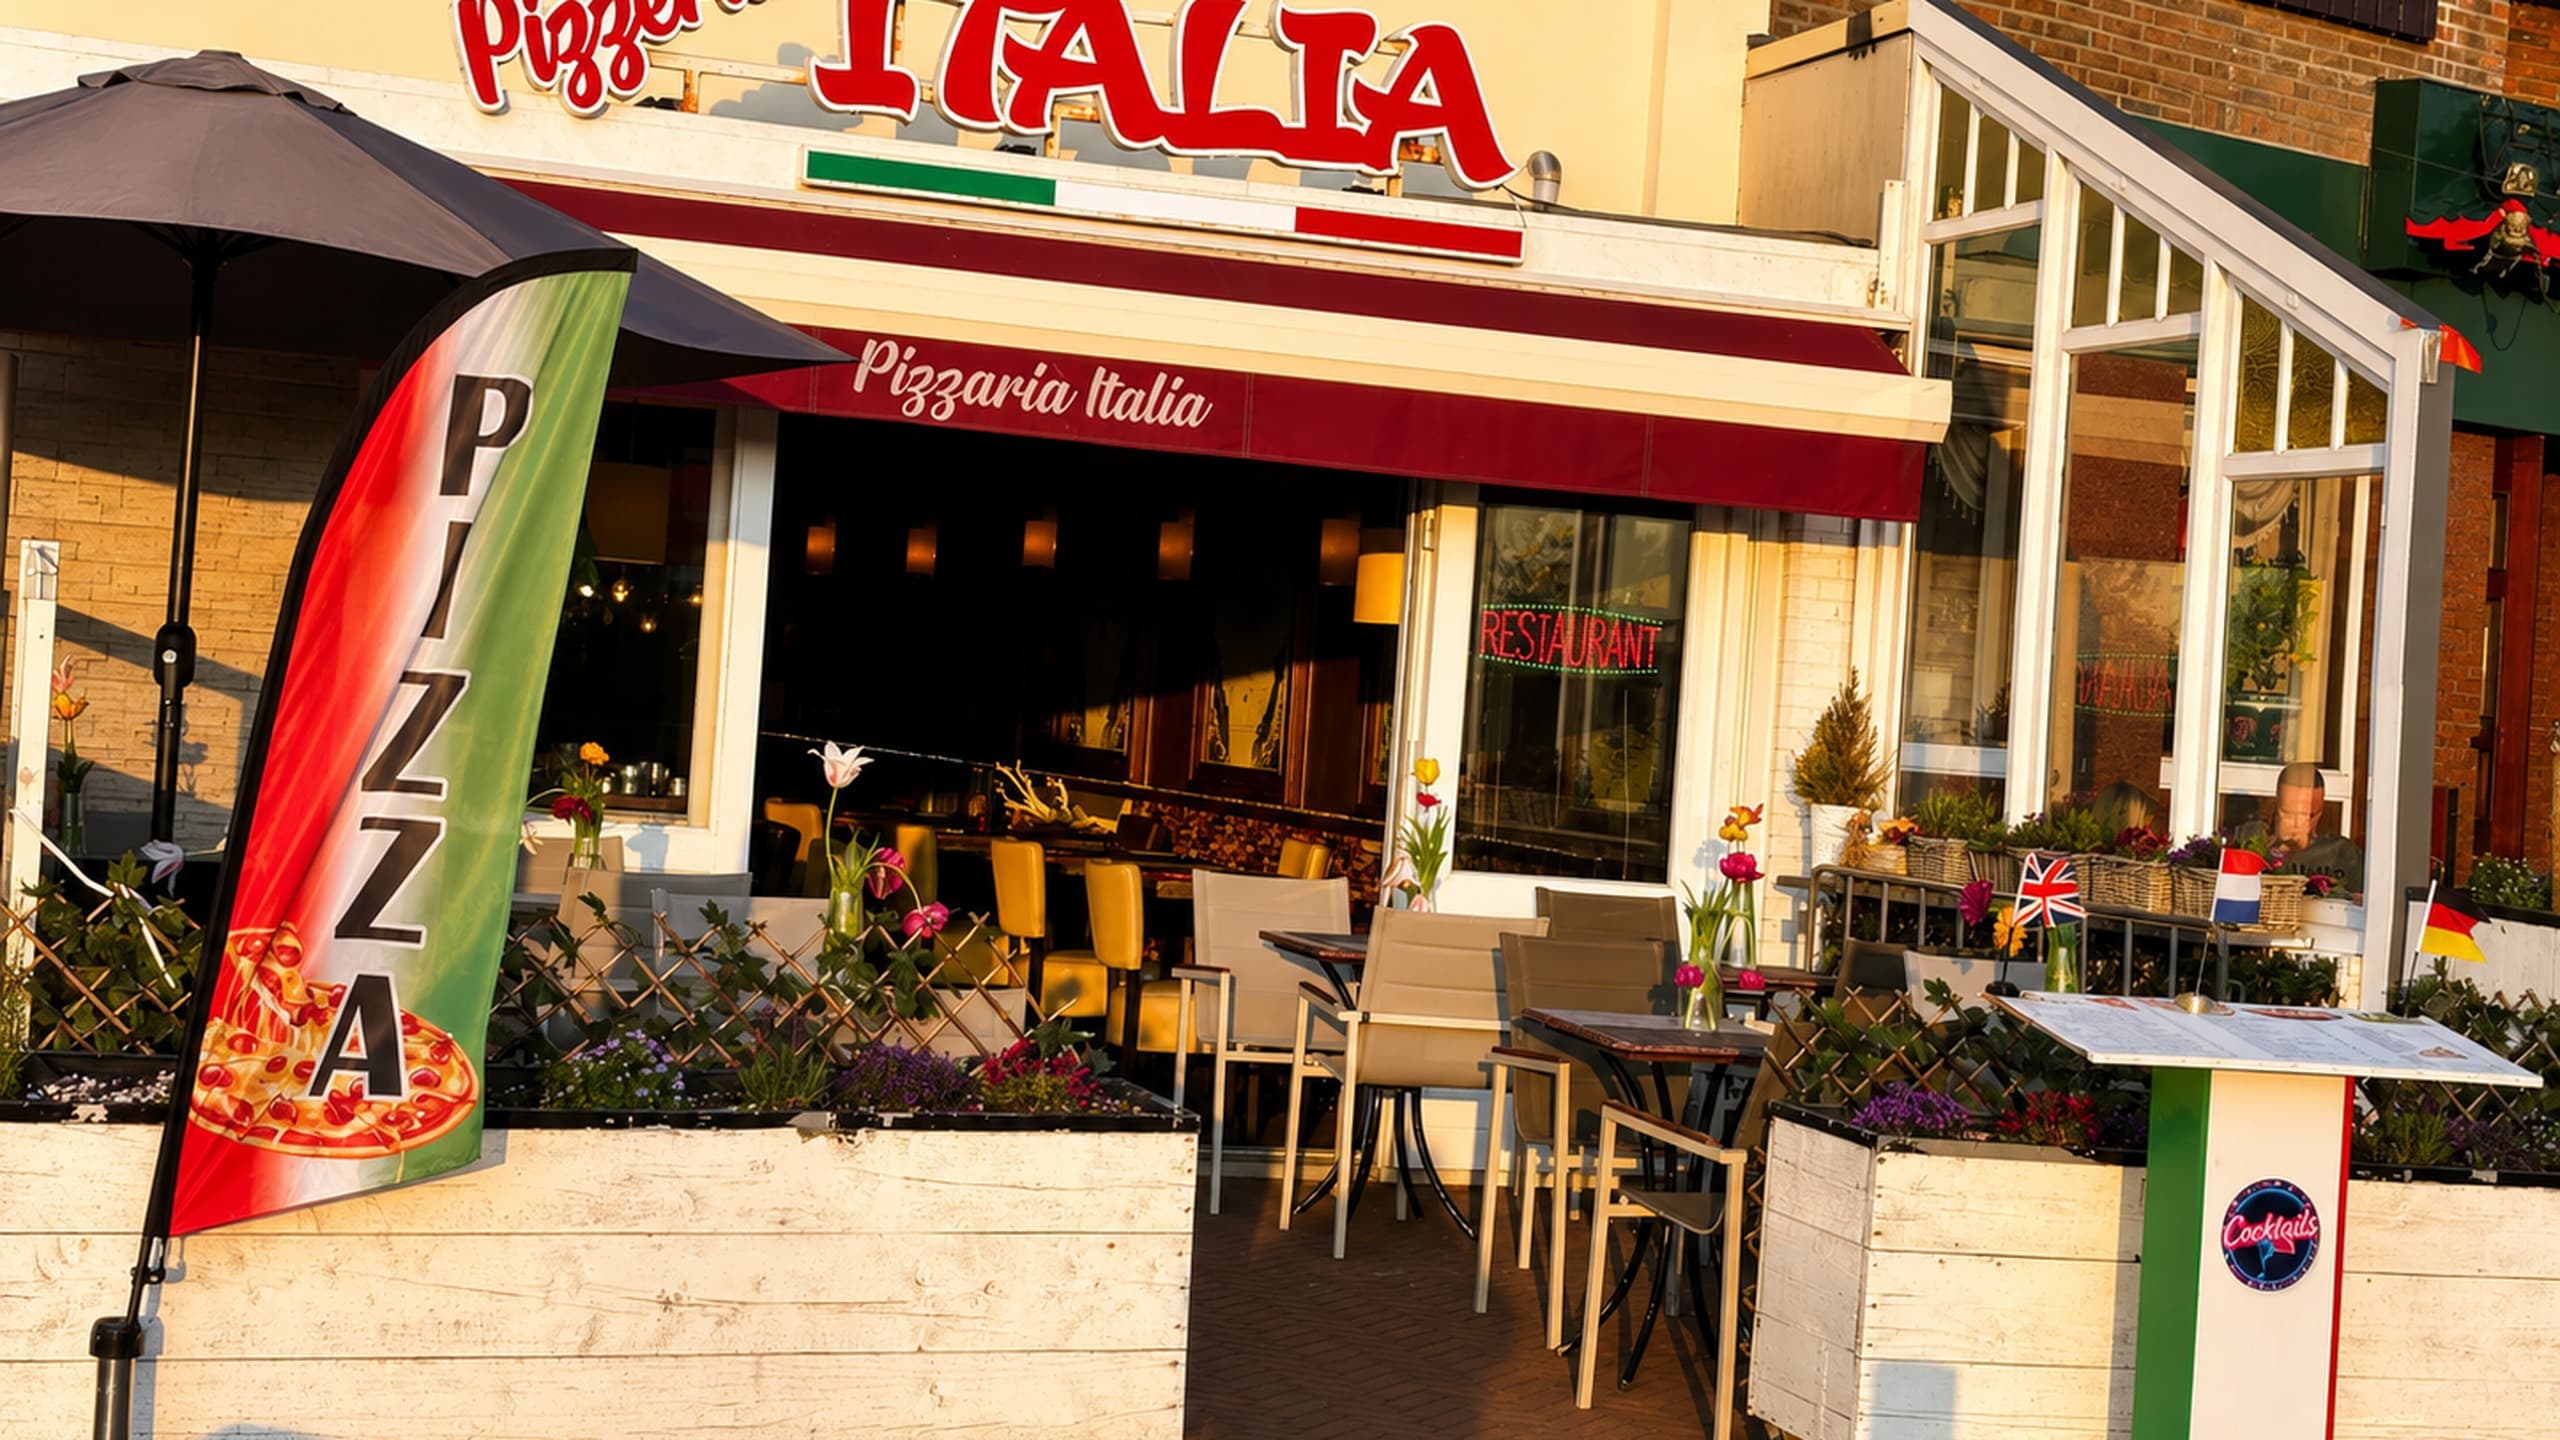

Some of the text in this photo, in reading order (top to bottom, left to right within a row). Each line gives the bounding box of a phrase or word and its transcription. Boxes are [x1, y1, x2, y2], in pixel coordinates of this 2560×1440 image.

[808, 0, 1517, 190] ITALIA
[853, 338, 1214, 428] Pizzaria Italia
[1480, 609, 1663, 669] RESTAURANT
[309, 373, 532, 1099] PIZZA
[2224, 1204, 2318, 1254] Cocktails
